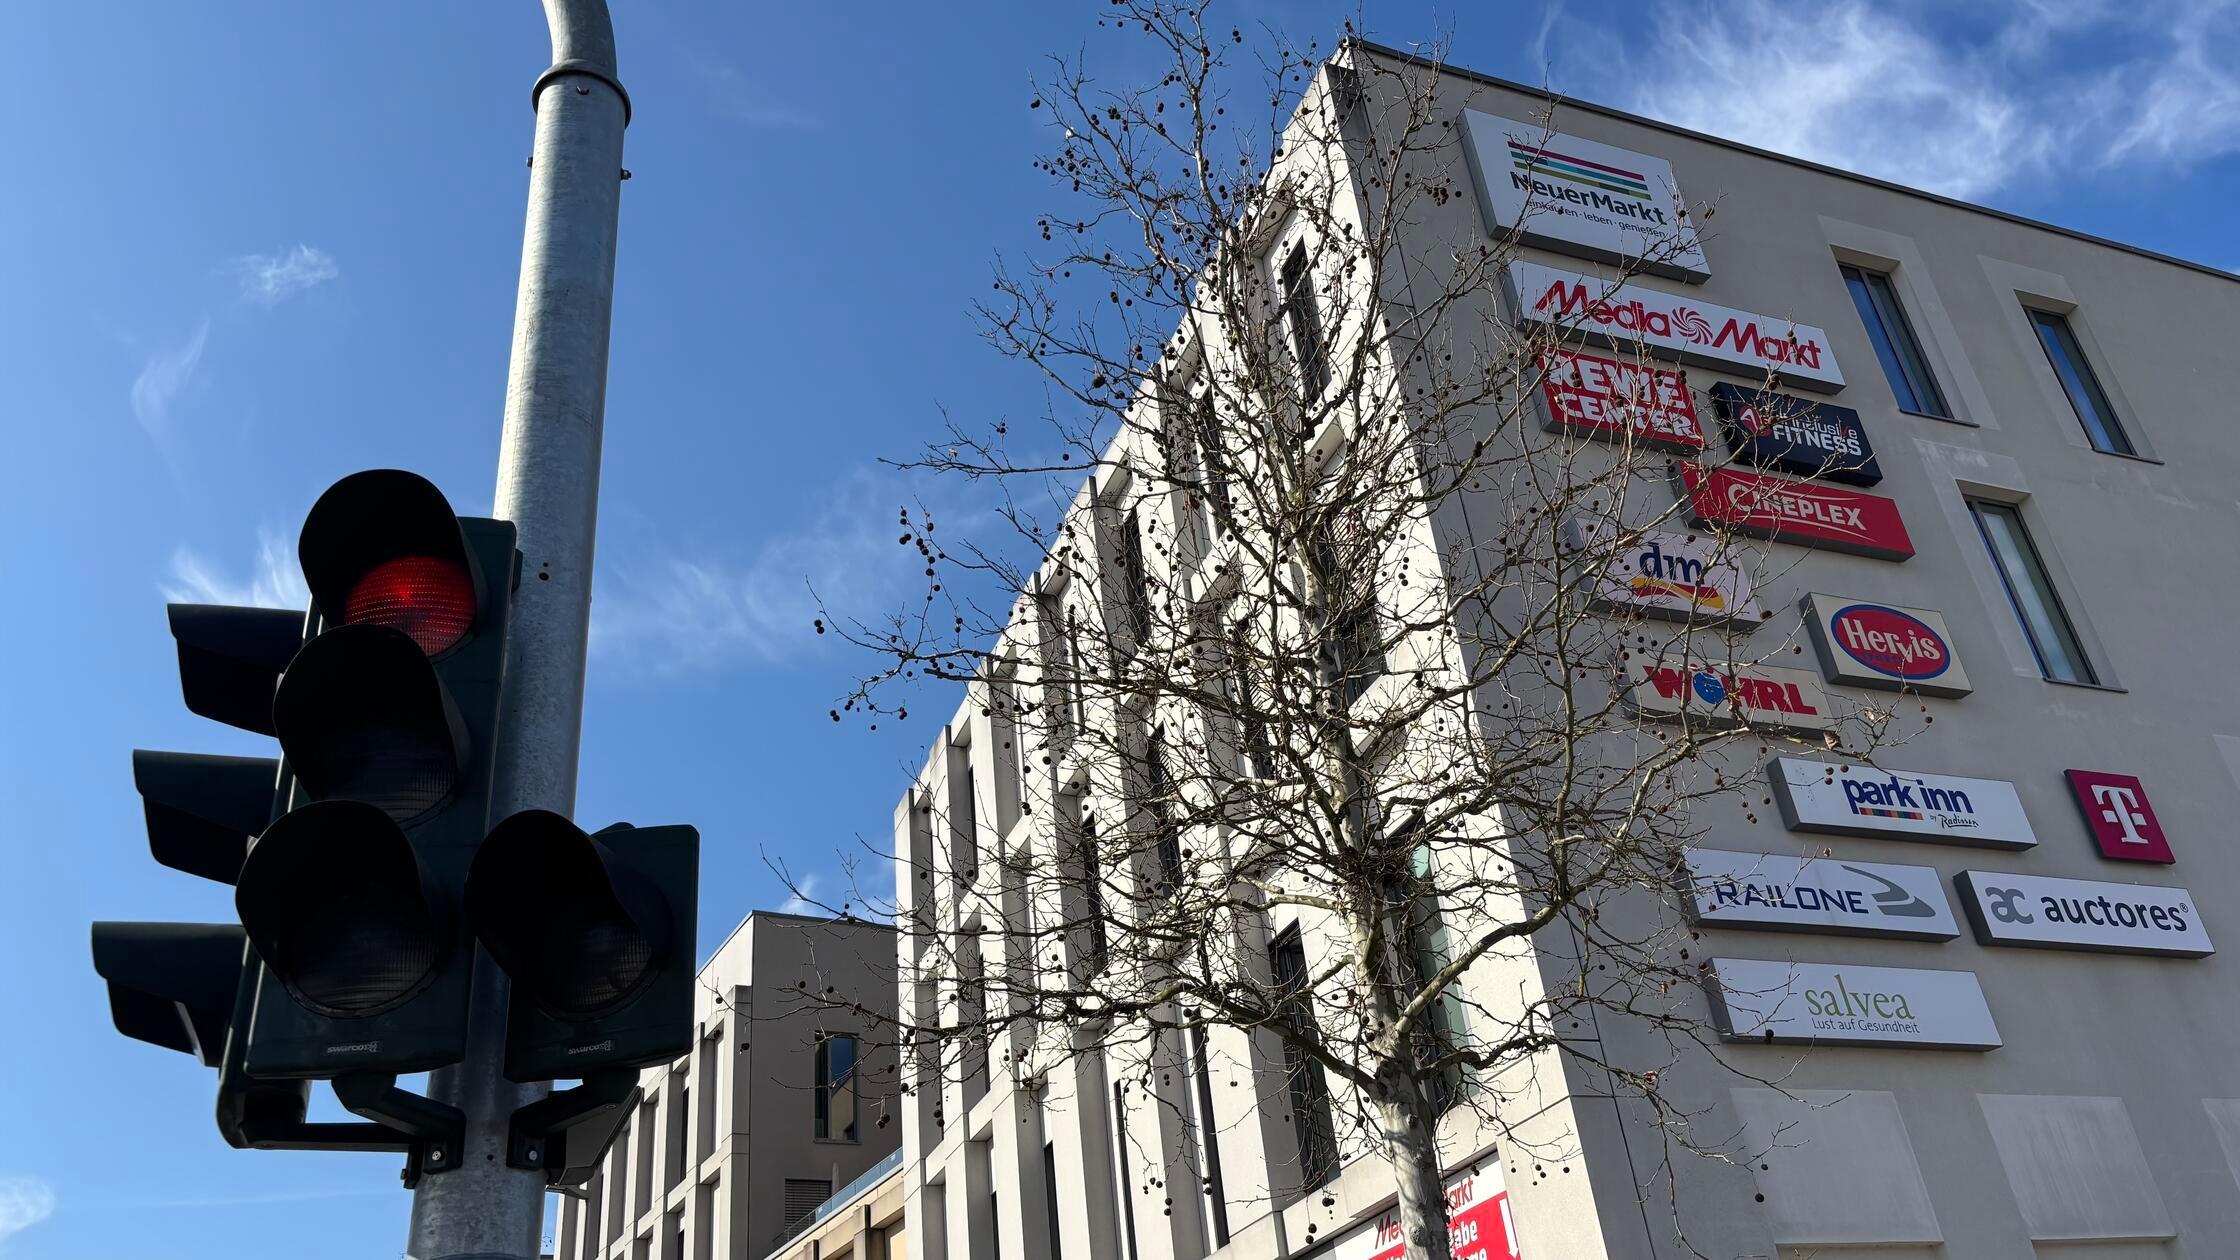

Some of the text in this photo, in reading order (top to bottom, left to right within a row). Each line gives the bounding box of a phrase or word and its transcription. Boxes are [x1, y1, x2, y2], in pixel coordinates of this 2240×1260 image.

[1510, 171, 1667, 226] NeuerMarkt
[1583, 211, 1613, 227] leben
[1536, 280, 1822, 370] Media Markt
[1543, 352, 1686, 409] REWE
[1556, 392, 1701, 440] CENTER
[1773, 424, 1862, 456] FITNESS
[1728, 483, 1867, 531] CINEPLEX
[1639, 542, 1705, 585] dm
[1840, 616, 1941, 664] Hervis
[1841, 775, 1974, 815] park inn
[1712, 880, 1870, 915] RAILONE
[1804, 973, 1916, 1021] salvea
[1811, 1017, 1921, 1035] Lust auf Gesundheit
